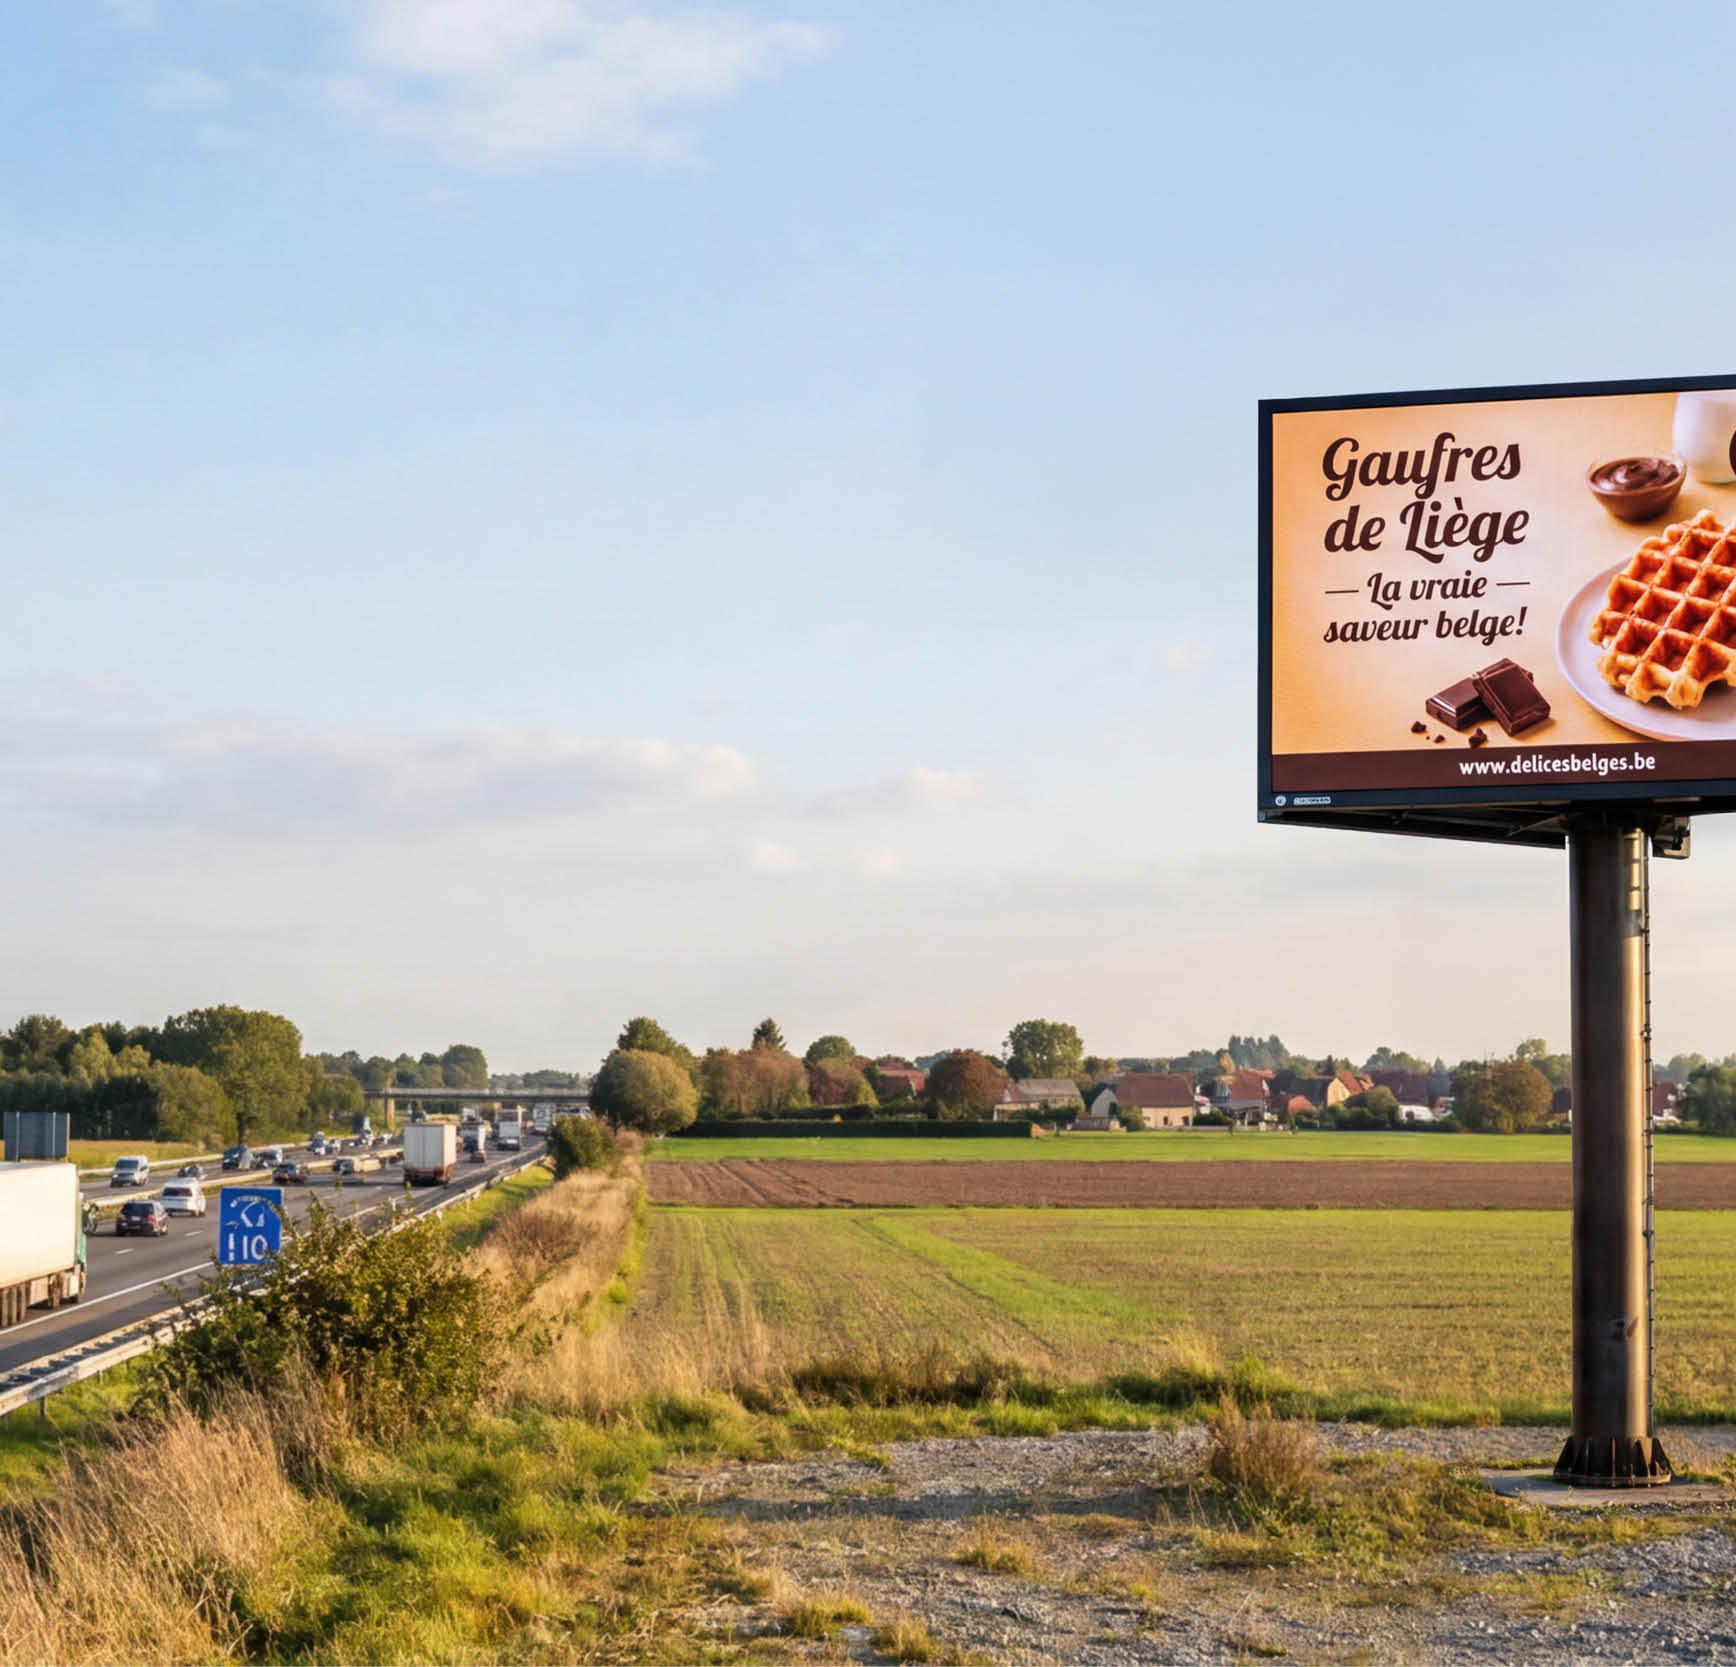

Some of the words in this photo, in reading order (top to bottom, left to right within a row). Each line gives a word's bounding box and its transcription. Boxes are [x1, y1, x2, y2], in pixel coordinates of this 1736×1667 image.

[1322, 432, 1521, 501] Gaufres
[1324, 504, 1386, 552] de
[1399, 497, 1530, 564] Liège
[1367, 572, 1401, 611] La
[1409, 570, 1487, 600] vraie
[1323, 618, 1428, 643] saveur
[1435, 606, 1528, 646] belge!
[1459, 752, 1656, 776] www.delicesbelges.be
